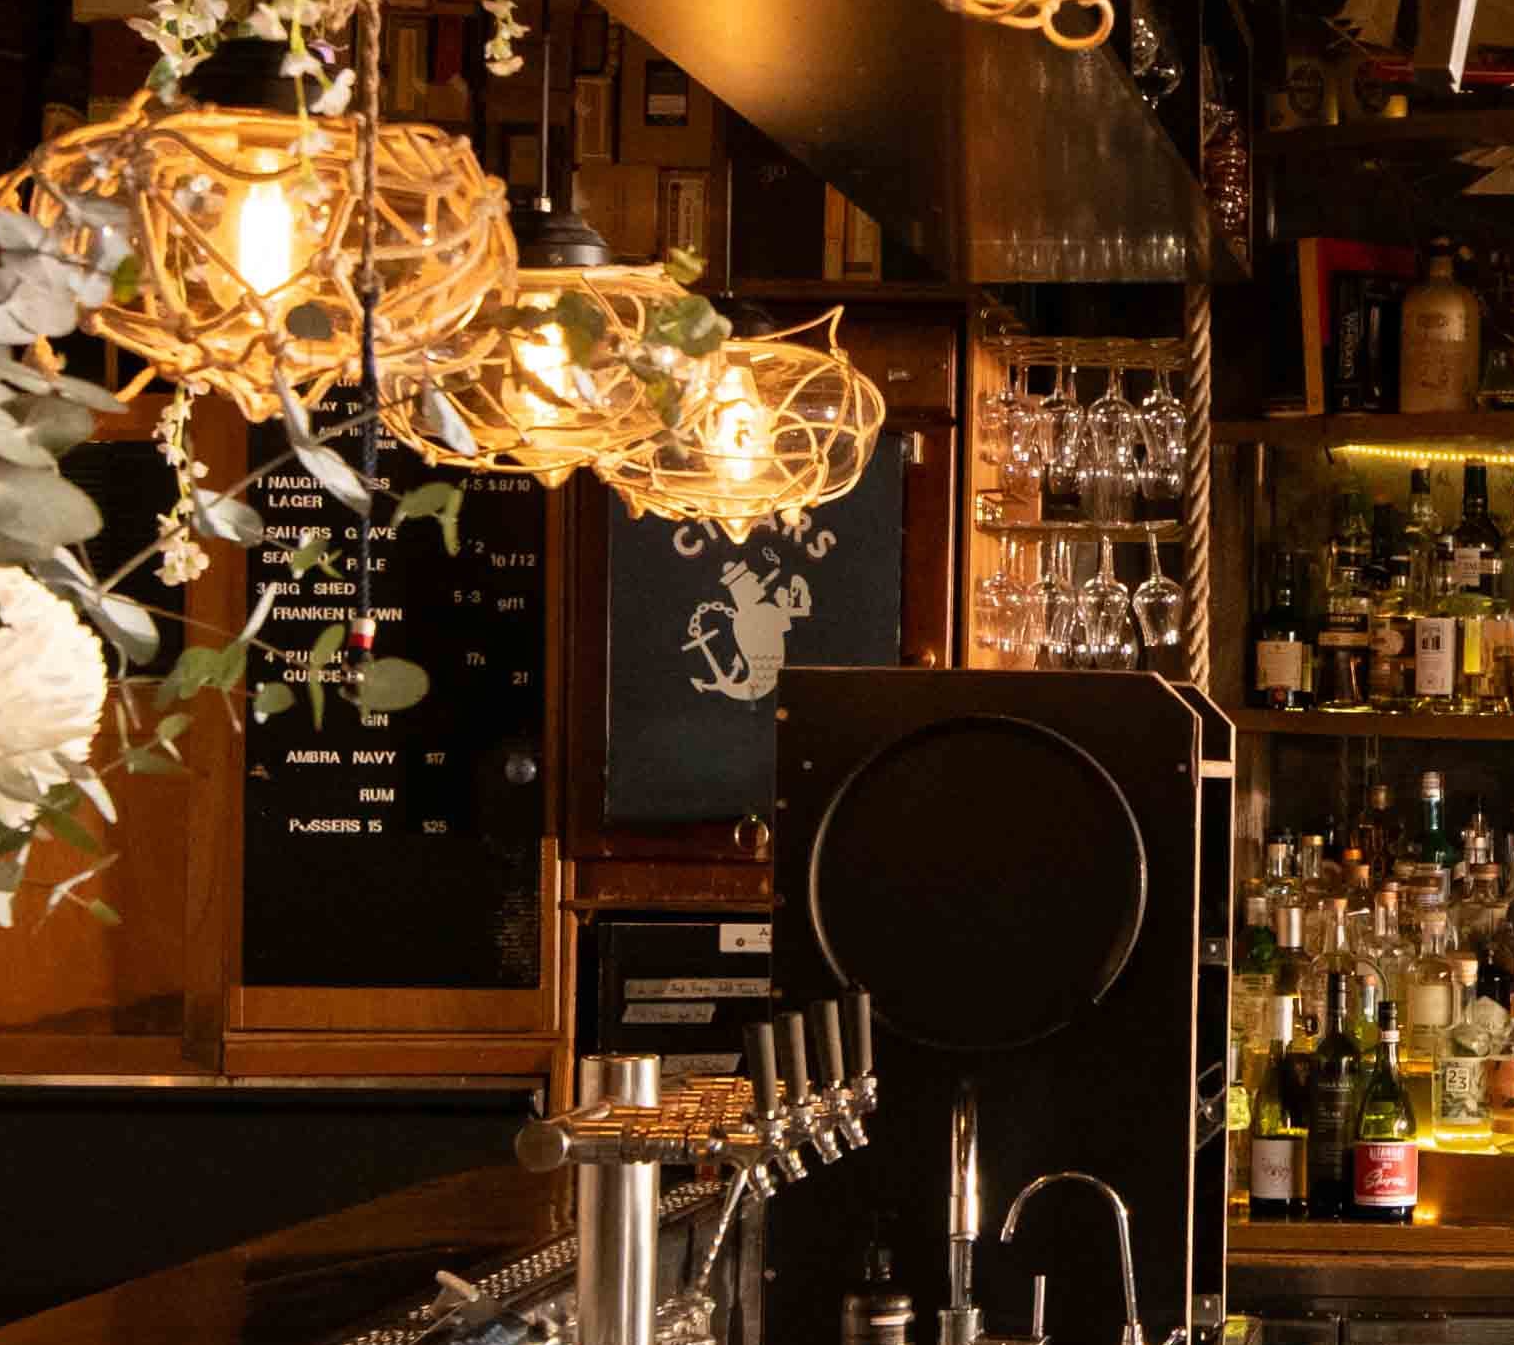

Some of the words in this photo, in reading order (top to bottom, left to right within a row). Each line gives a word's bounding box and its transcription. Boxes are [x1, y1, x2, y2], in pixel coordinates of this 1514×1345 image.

[267, 494, 324, 509] LAGER
[265, 525, 333, 540] SAILORS
[344, 526, 398, 541] GAVE
[673, 511, 836, 557] CIARS
[272, 582, 301, 596] BIG
[313, 582, 357, 596] SHED
[360, 714, 389, 727] GIN
[286, 750, 341, 765] AMBRA
[352, 750, 397, 765] NAVY
[358, 787, 395, 804] RUM
